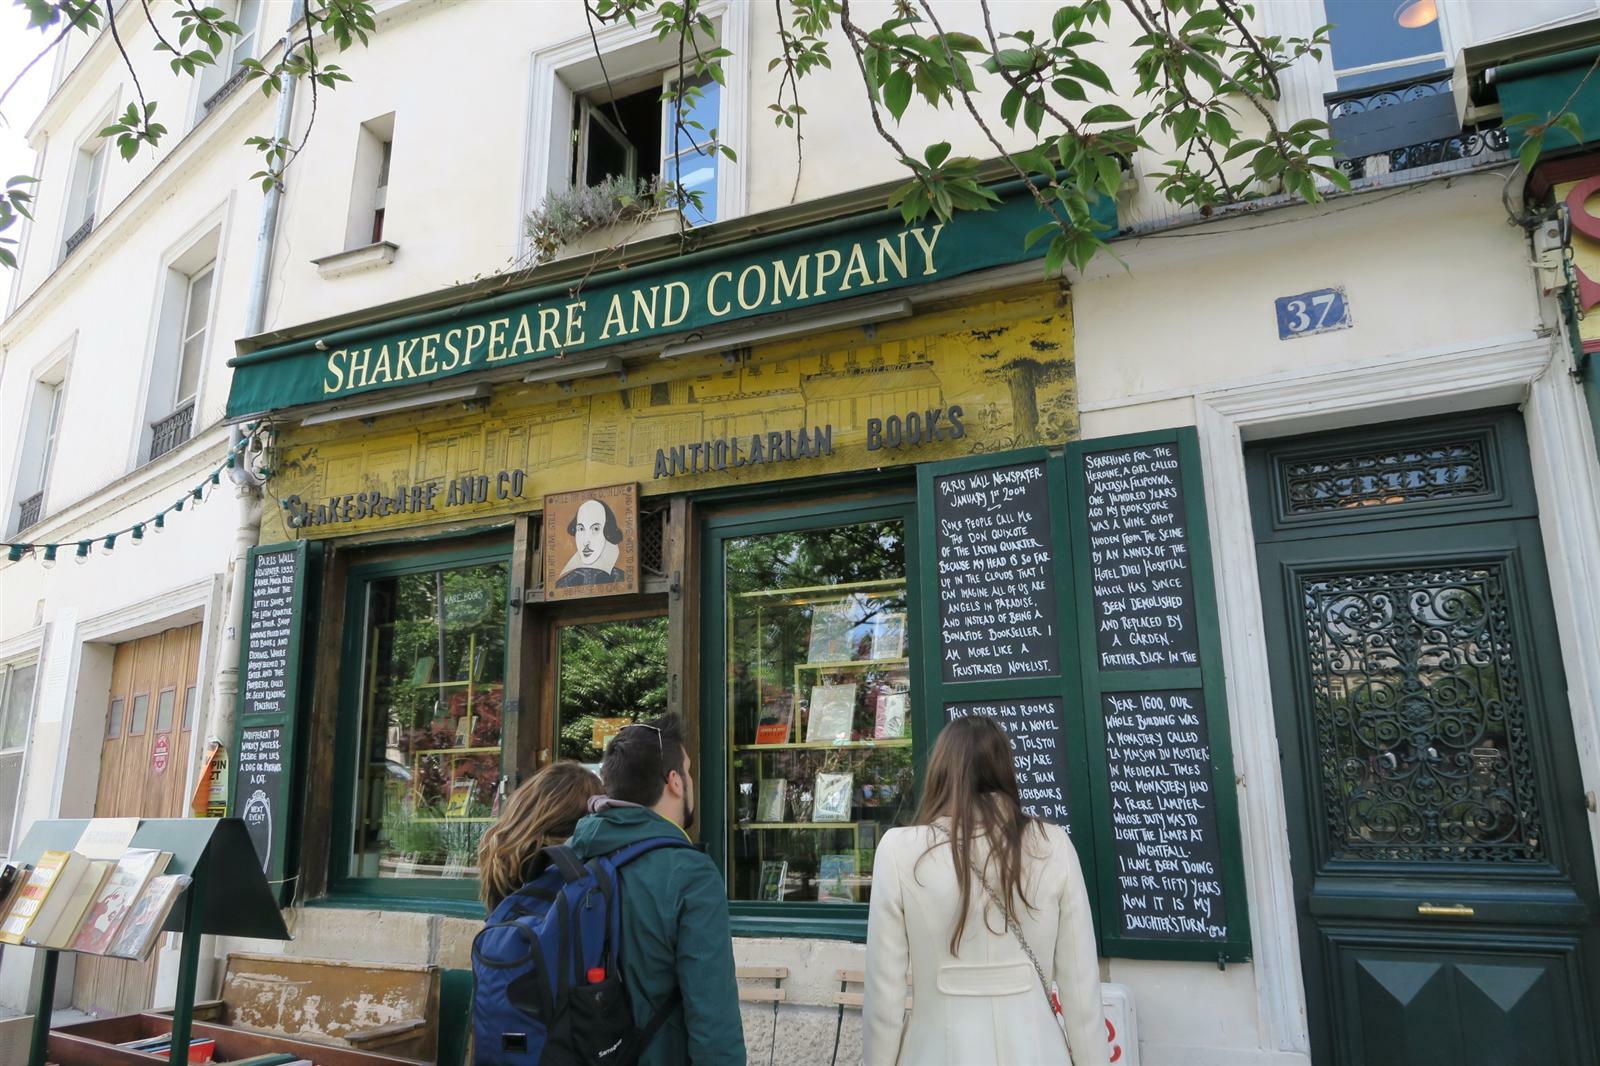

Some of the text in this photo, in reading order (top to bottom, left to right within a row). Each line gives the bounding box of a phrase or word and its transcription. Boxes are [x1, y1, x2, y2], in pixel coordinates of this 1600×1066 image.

[323, 225, 944, 393] SHAKESPEARE AND COMPANY
[1287, 293, 1336, 332] 37
[867, 405, 966, 451] BOOKS
[1086, 448, 1171, 470] SEARCHING FOR THE
[1086, 460, 1177, 484] HEROINE, GIRL CALLED
[445, 474, 489, 508] AND
[496, 468, 526, 500] CO
[940, 467, 1042, 495] PARIS WALL NEWSPAPER
[951, 487, 1026, 508] JANUARY 2004
[1088, 487, 1177, 505] ONE HUNDRED YEARS
[1088, 506, 1102, 517] AGO
[1107, 506, 1118, 517] MY
[942, 511, 1032, 535] SOME PEOPLE CALL ME
[1090, 514, 1174, 532] WAS WINE SHOP
[949, 527, 1028, 545] THE DON QUIXOTE
[1092, 528, 1183, 549] HIDDEN FROM SEINE
[942, 538, 1044, 558] OF THE LATIN QUARTER
[1123, 544, 1186, 558] ANNEX THE
[258, 553, 294, 567] PARIS WALL
[939, 552, 1050, 573] BECAUSE MY HEAD SO FAR
[941, 568, 1035, 588] UP IN THE CLOUDS THAT
[1094, 559, 1186, 581] HOTEL DIEU HOSPITAL
[942, 581, 1046, 600] CAN IMAGINE ALL ARE
[1094, 578, 1182, 596] WHICH HAS SINCE
[948, 602, 980, 613] ANGELS
[1102, 596, 1182, 615] BEEN DEMOLISHED
[943, 612, 1031, 628] AND INSTEAD OF BEING
[1100, 614, 1183, 631] AND REPLACED BY
[942, 626, 1042, 643] BONAFIDE BOOKSELLER
[1129, 633, 1173, 645] GARDEN.
[945, 644, 1012, 660] AM MORE LIKE
[1101, 650, 1197, 666] FURTHER BACK IN THE
[952, 660, 1051, 677] FRUSTRATED NOVELIST.
[946, 703, 1055, 721] THIS STORE HAS ROOMS
[1109, 696, 1192, 713] YEAR 1600, OUR
[1010, 722, 1018, 732] IN
[1030, 721, 1059, 730] NOVEL
[1105, 714, 1199, 729] WHOLE BUILDING WAS
[1017, 735, 1056, 751] TOLSTOI
[1116, 732, 1198, 745] MONASTERY CALLED
[1033, 753, 1052, 765] ARE
[1124, 747, 1156, 761] MAISON
[1032, 772, 1055, 782] THAN
[1109, 762, 1200, 778] IN MEDIEVAL TIMES
[1019, 787, 1062, 800] IGHBOURS
[1135, 779, 1187, 797] MONASTERY
[1190, 779, 1208, 792] HAD
[1041, 806, 1052, 816] TO
[1055, 805, 1068, 817] ME
[1125, 795, 1205, 811] FRERE LAMPIER
[1114, 813, 1185, 830] WHOSE DUTY WAS
[1115, 827, 1203, 844] LIGHT THE LAMPS AT
[1137, 842, 1191, 858] NIGHTFALL.
[1127, 857, 1213, 874] HAVE BEEN DOING
[1119, 875, 1221, 898] THIS FOR FIFTY YEARS
[1122, 893, 1211, 918] NOW MY
[1126, 913, 1179, 932] DAUGHTER'S
